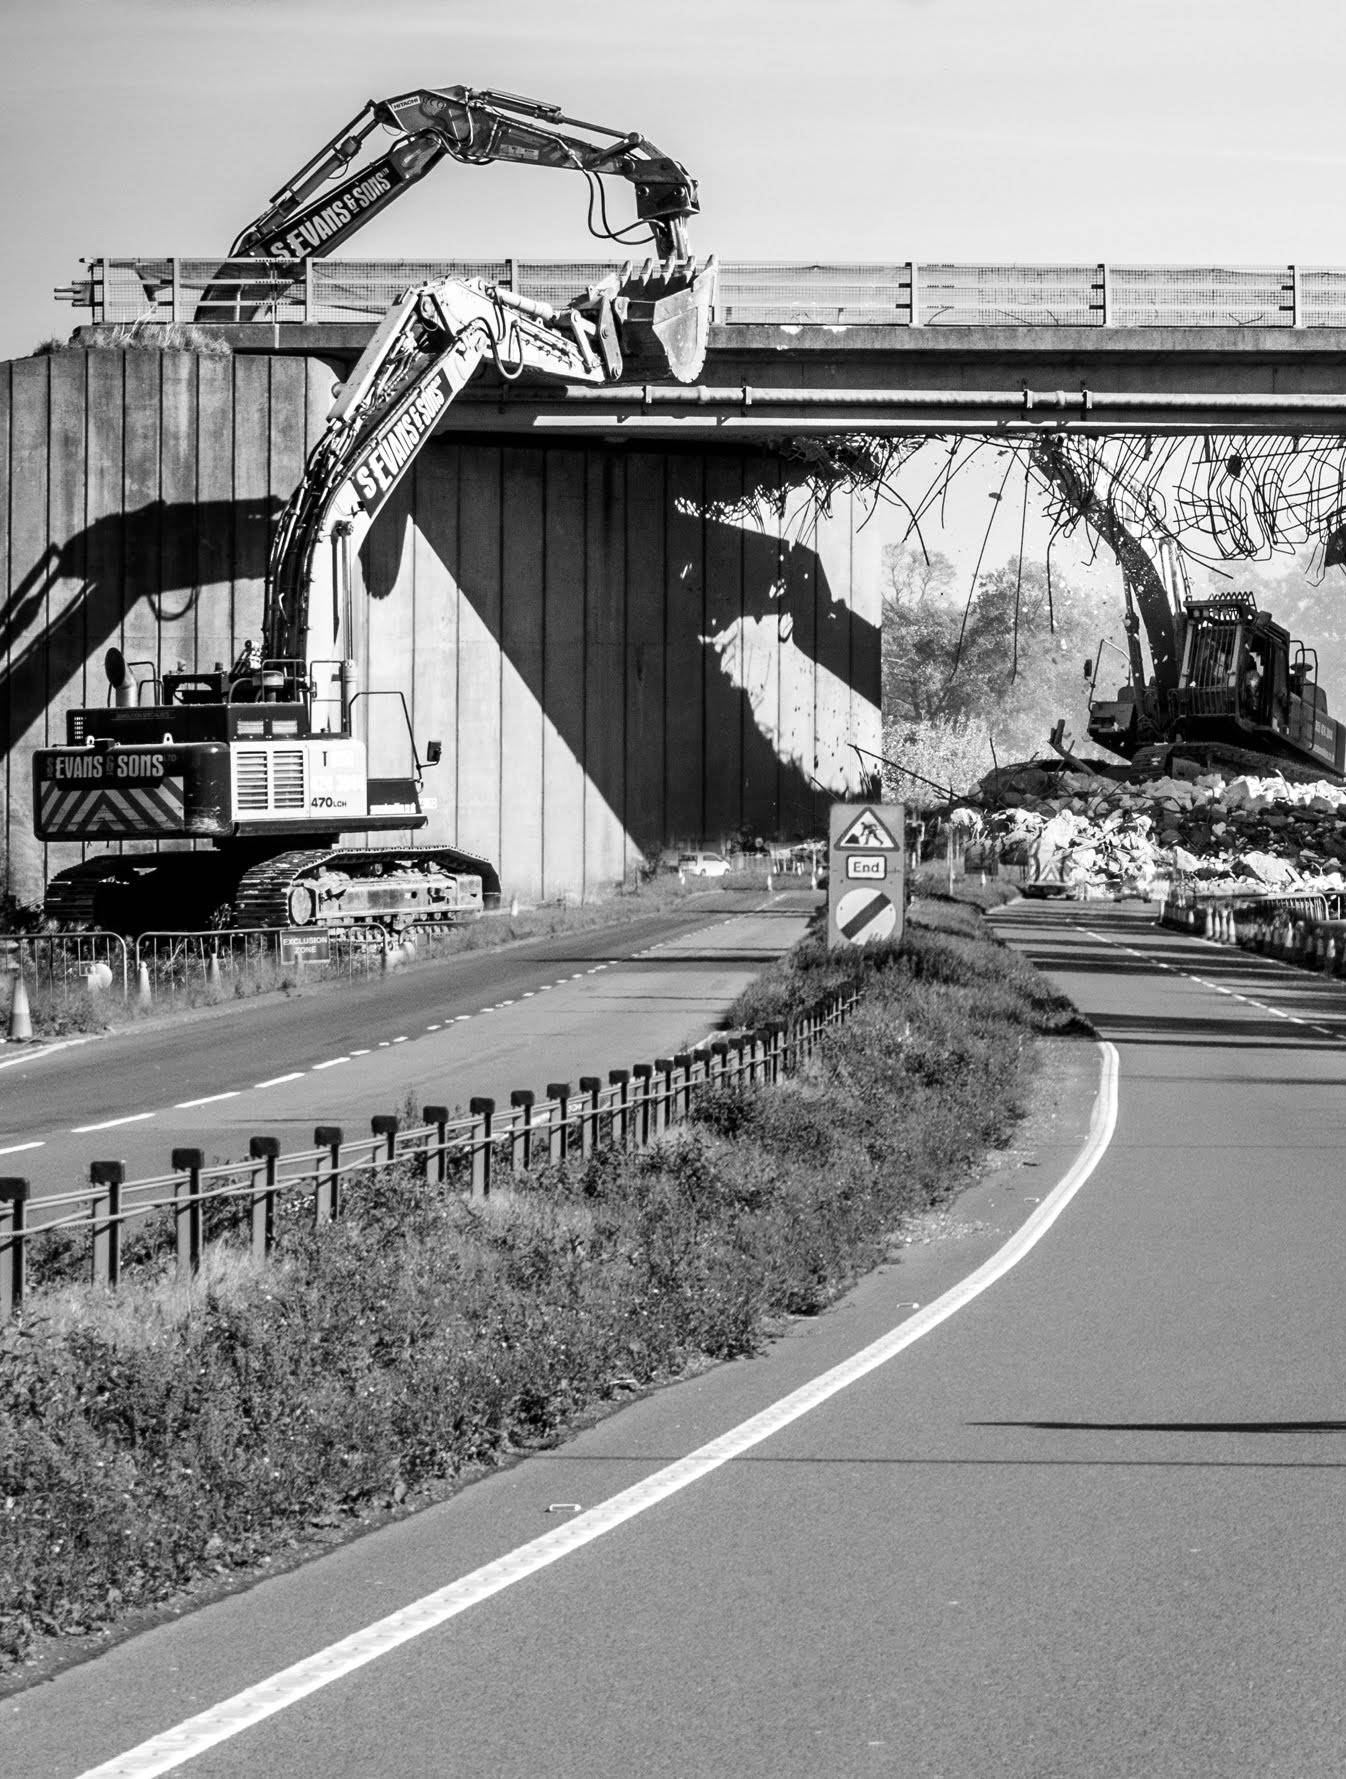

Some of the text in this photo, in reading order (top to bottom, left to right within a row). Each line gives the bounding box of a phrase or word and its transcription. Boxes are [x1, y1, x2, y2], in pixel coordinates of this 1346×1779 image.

[393, 98, 418, 109] HITACHI
[286, 200, 351, 258] EVANS
[343, 193, 360, 213] &
[352, 172, 391, 208] SONS
[356, 466, 377, 499] S
[368, 413, 420, 492] EVANS
[415, 386, 444, 426] SONS
[56, 755, 103, 778] EVANS
[117, 753, 164, 778] SONS
[854, 862, 879, 873] End
[283, 936, 328, 946] EXCLUSION
[294, 945, 317, 954] ZONE
